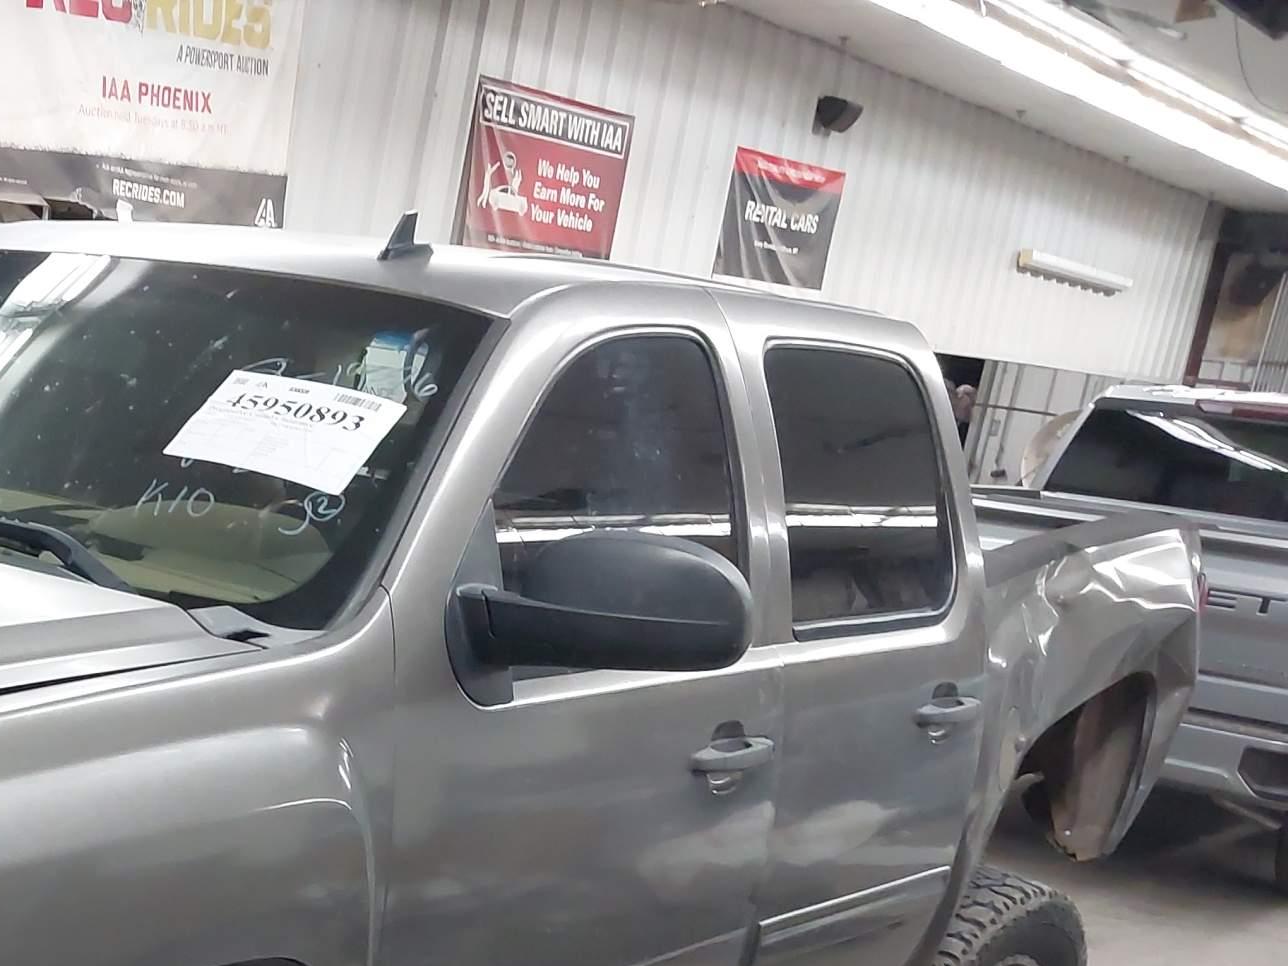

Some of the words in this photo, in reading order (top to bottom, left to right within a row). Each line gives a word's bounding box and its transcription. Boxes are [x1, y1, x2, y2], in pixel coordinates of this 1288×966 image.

[185, 47, 234, 72] POWERSPORT
[237, 56, 269, 76] AUCTION
[102, 75, 132, 103] IAA
[138, 82, 213, 114] PHOENIX
[484, 93, 516, 125] SELL
[518, 102, 567, 137] SMART
[568, 114, 601, 146] WITH
[601, 123, 622, 152] IAA
[538, 158, 554, 178] We
[556, 163, 580, 187] Help
[582, 168, 600, 189] You
[112, 178, 185, 208] RECRIDES.COM
[533, 182, 558, 202] Earn
[559, 187, 585, 208] More
[588, 193, 605, 212] For
[530, 204, 554, 224] Your
[556, 209, 593, 232] Vehicle
[744, 200, 788, 229] RENTAL
[789, 213, 819, 234] CARS
[227, 392, 365, 432] 45950893
